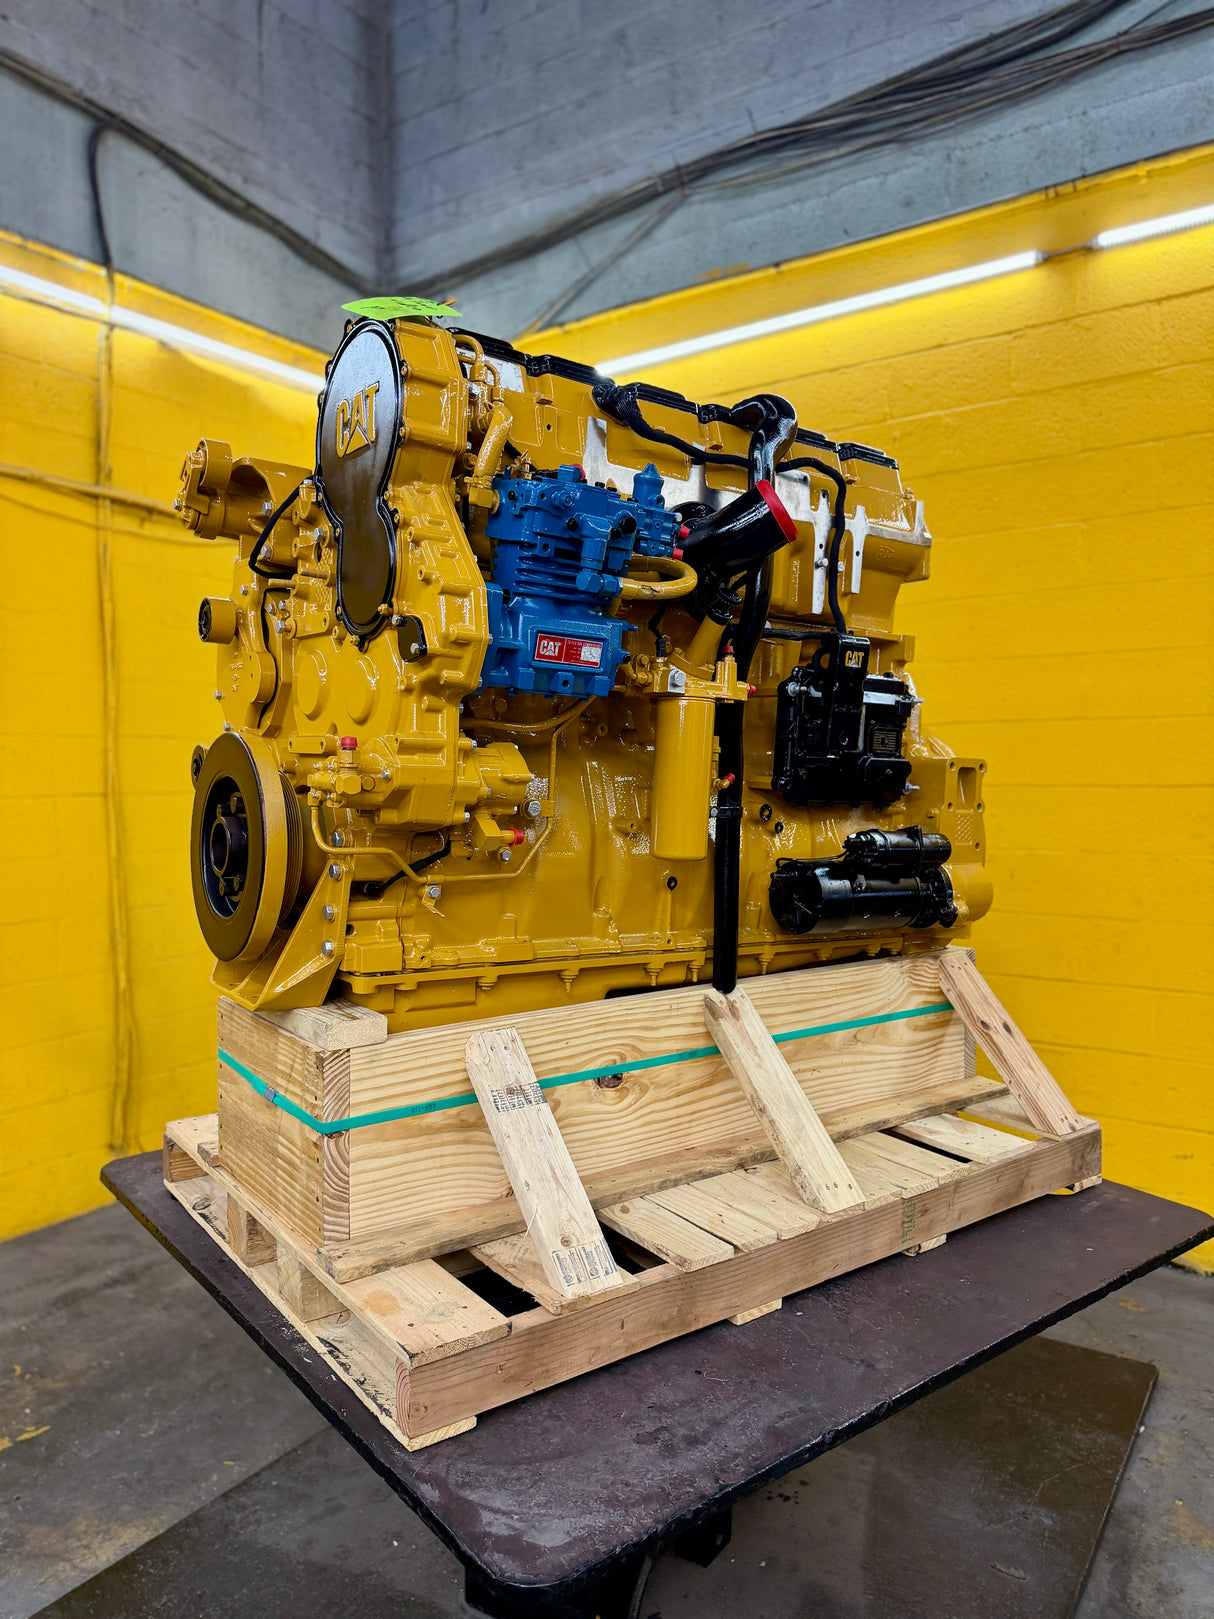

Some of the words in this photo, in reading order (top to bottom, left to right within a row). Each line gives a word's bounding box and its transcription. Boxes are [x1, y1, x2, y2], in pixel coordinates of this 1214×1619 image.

[336, 381, 380, 458] CAT
[539, 640, 561, 656] CAT
[845, 650, 864, 668] CAT
